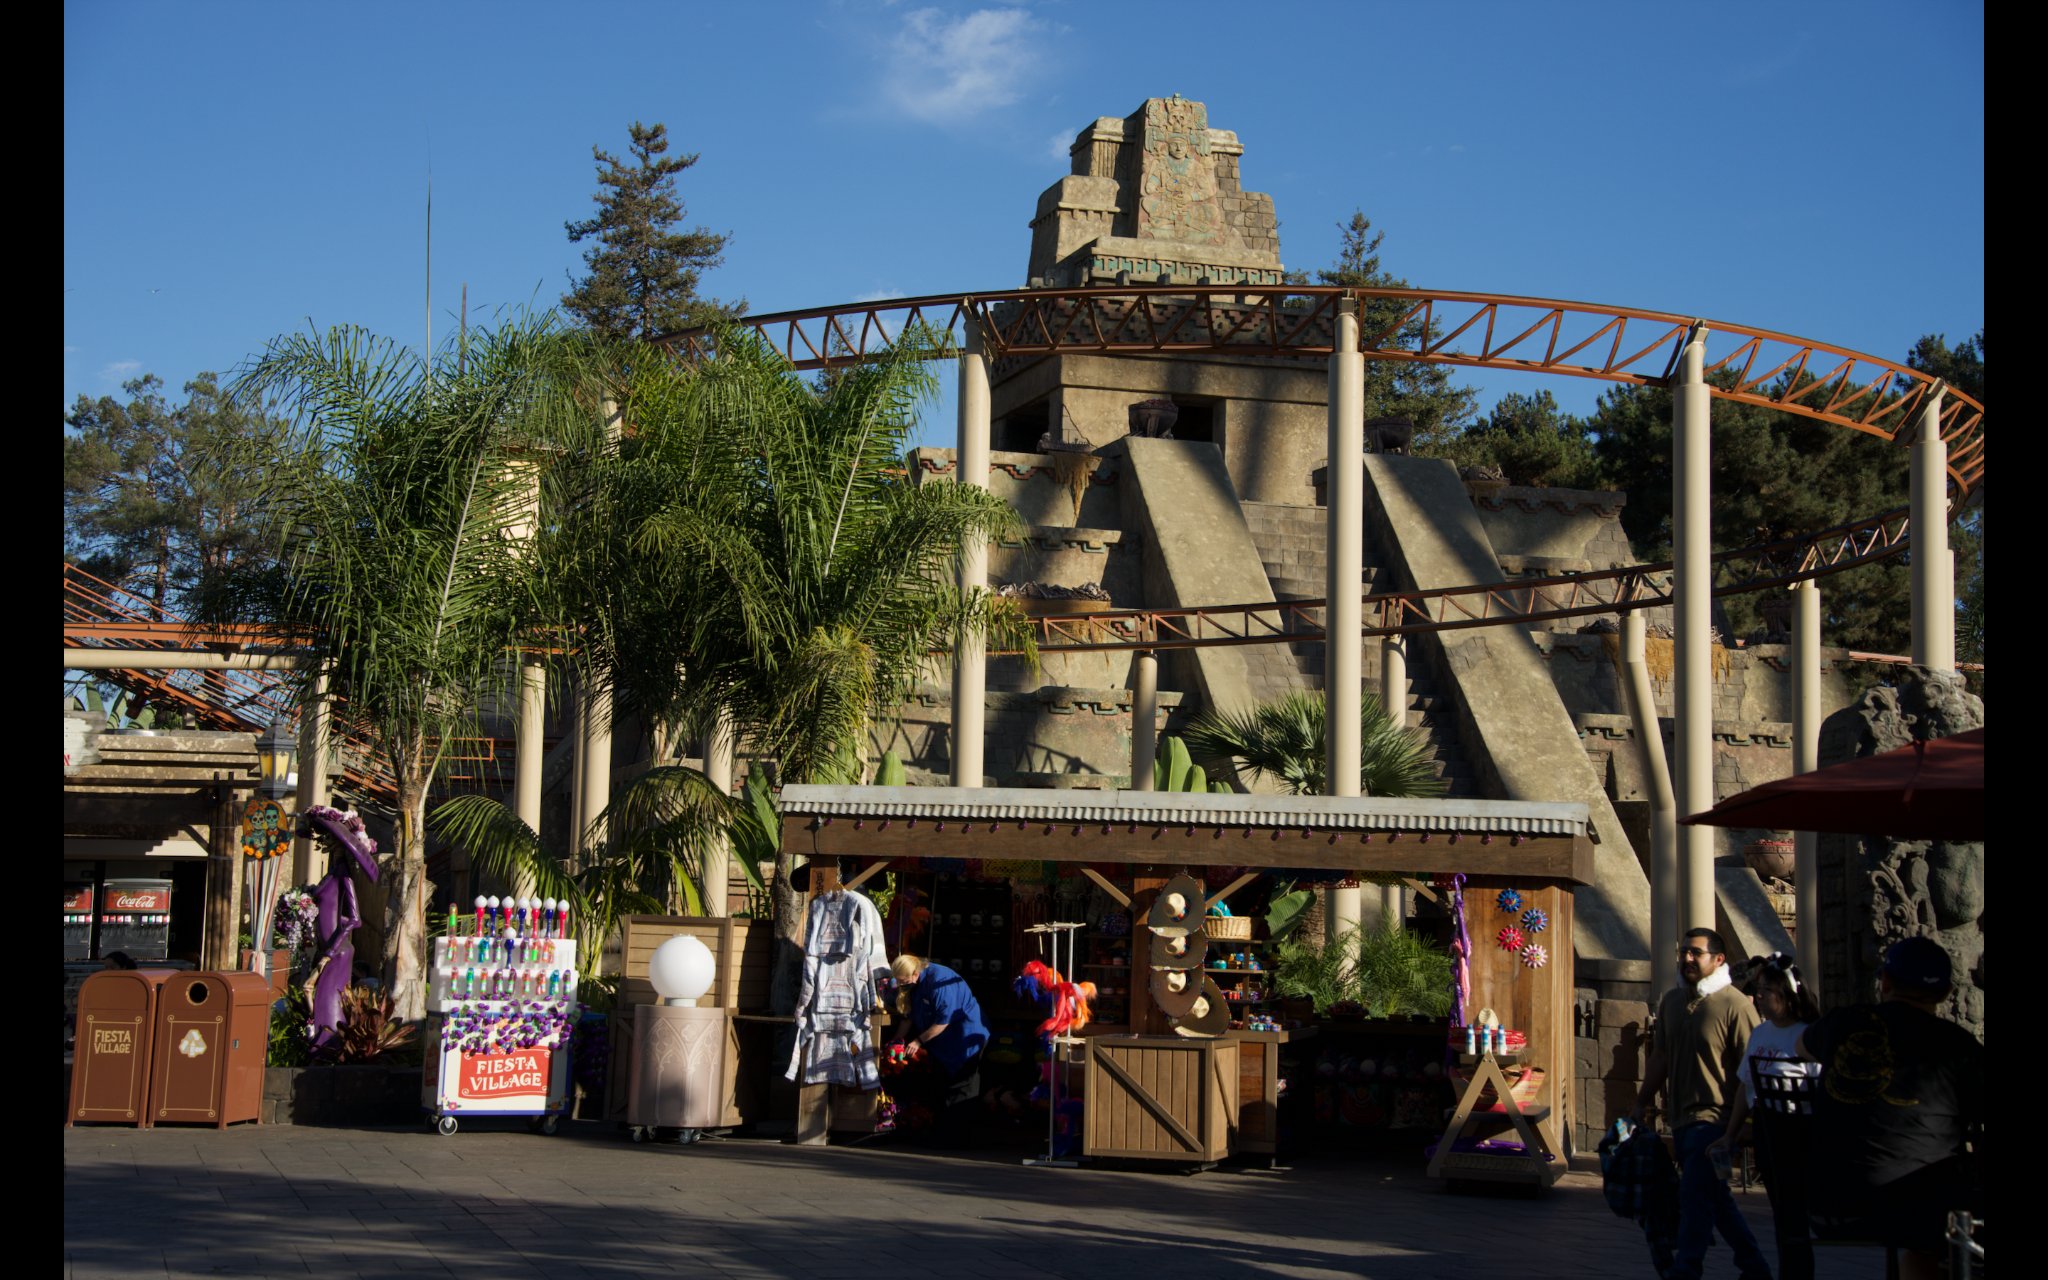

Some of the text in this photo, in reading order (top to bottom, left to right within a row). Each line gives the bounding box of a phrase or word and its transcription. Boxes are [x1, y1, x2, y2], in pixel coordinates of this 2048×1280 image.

[95, 1030, 132, 1043] FIESTA
[94, 1042, 131, 1054] VILLAGE
[476, 1056, 538, 1075] FIESTA
[470, 1072, 542, 1091] VILLAGE
